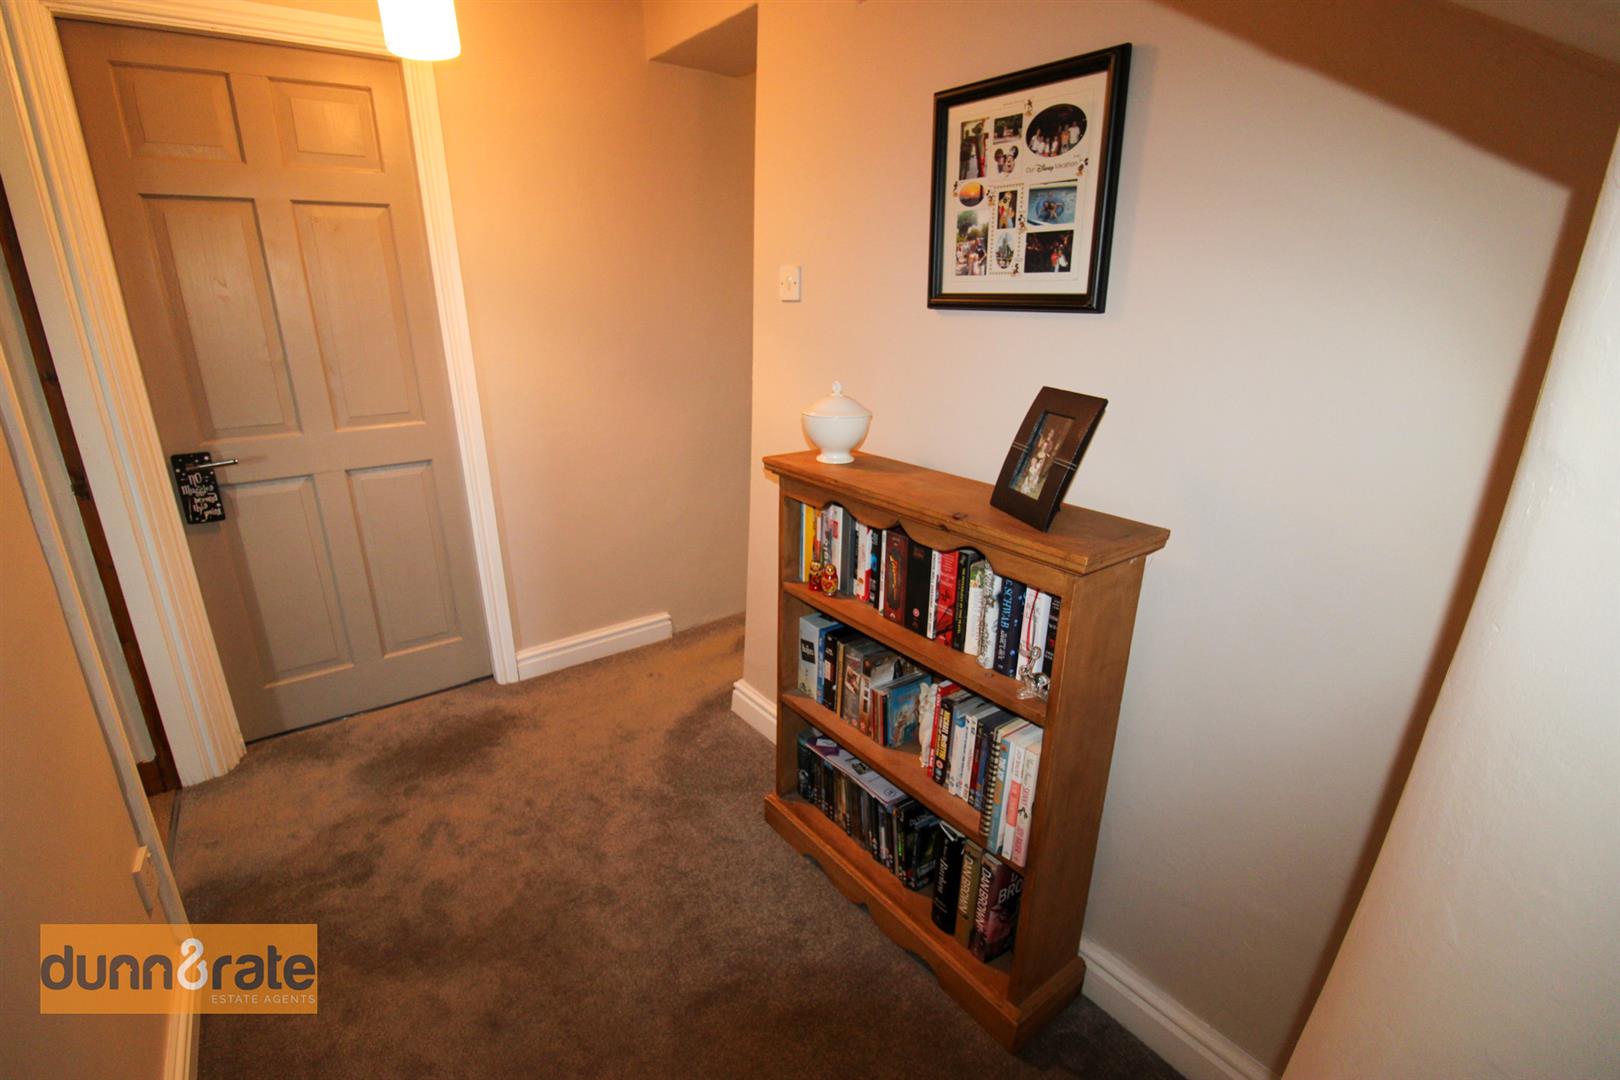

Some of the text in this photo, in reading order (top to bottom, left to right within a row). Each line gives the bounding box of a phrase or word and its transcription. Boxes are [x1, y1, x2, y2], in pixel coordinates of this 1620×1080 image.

[1000, 585, 1013, 629] SCHWAB
[958, 854, 974, 914] DAN BROWN
[975, 867, 992, 931] DAN BROWN
